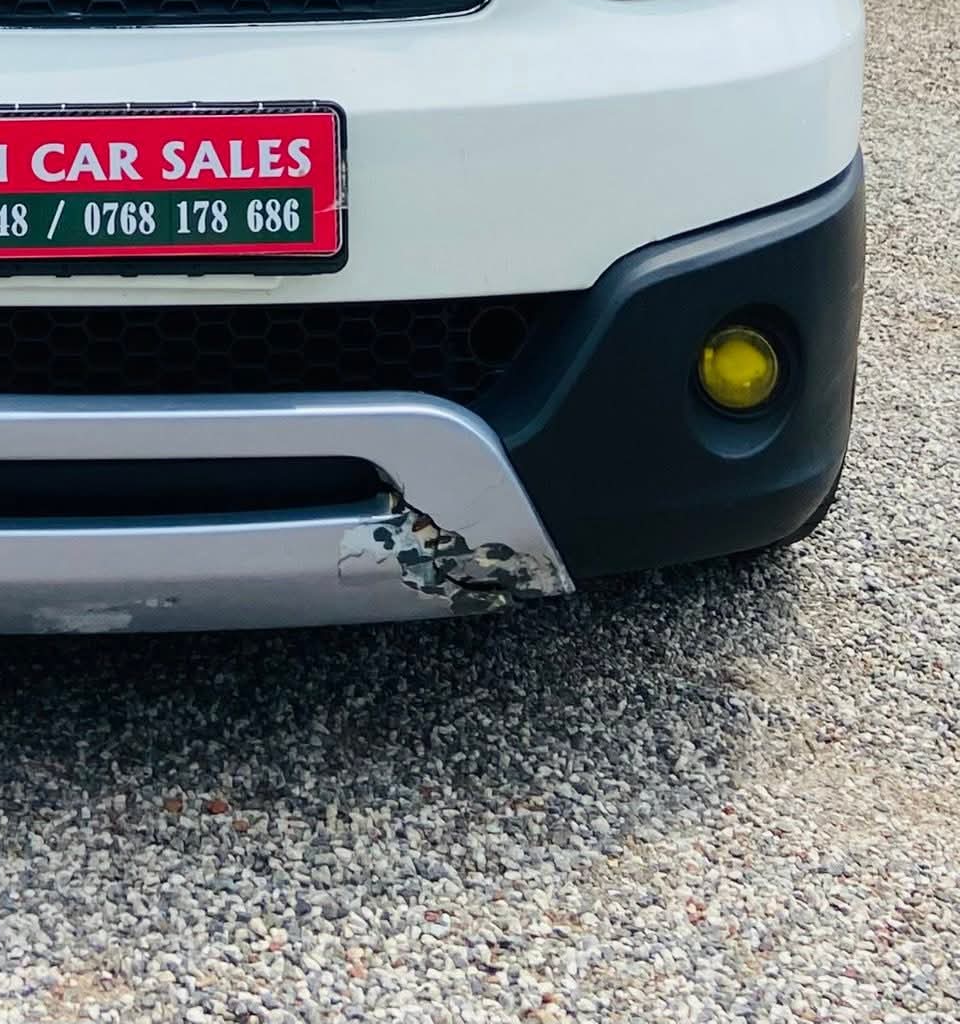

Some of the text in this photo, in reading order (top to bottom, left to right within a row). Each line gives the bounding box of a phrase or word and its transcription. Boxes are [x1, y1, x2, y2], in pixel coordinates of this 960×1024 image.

[31, 143, 143, 182] CAR
[162, 139, 312, 180] SALES
[47, 199, 65, 240] /
[84, 202, 156, 235] 0768
[177, 200, 229, 234] 178
[246, 198, 300, 233] 686
